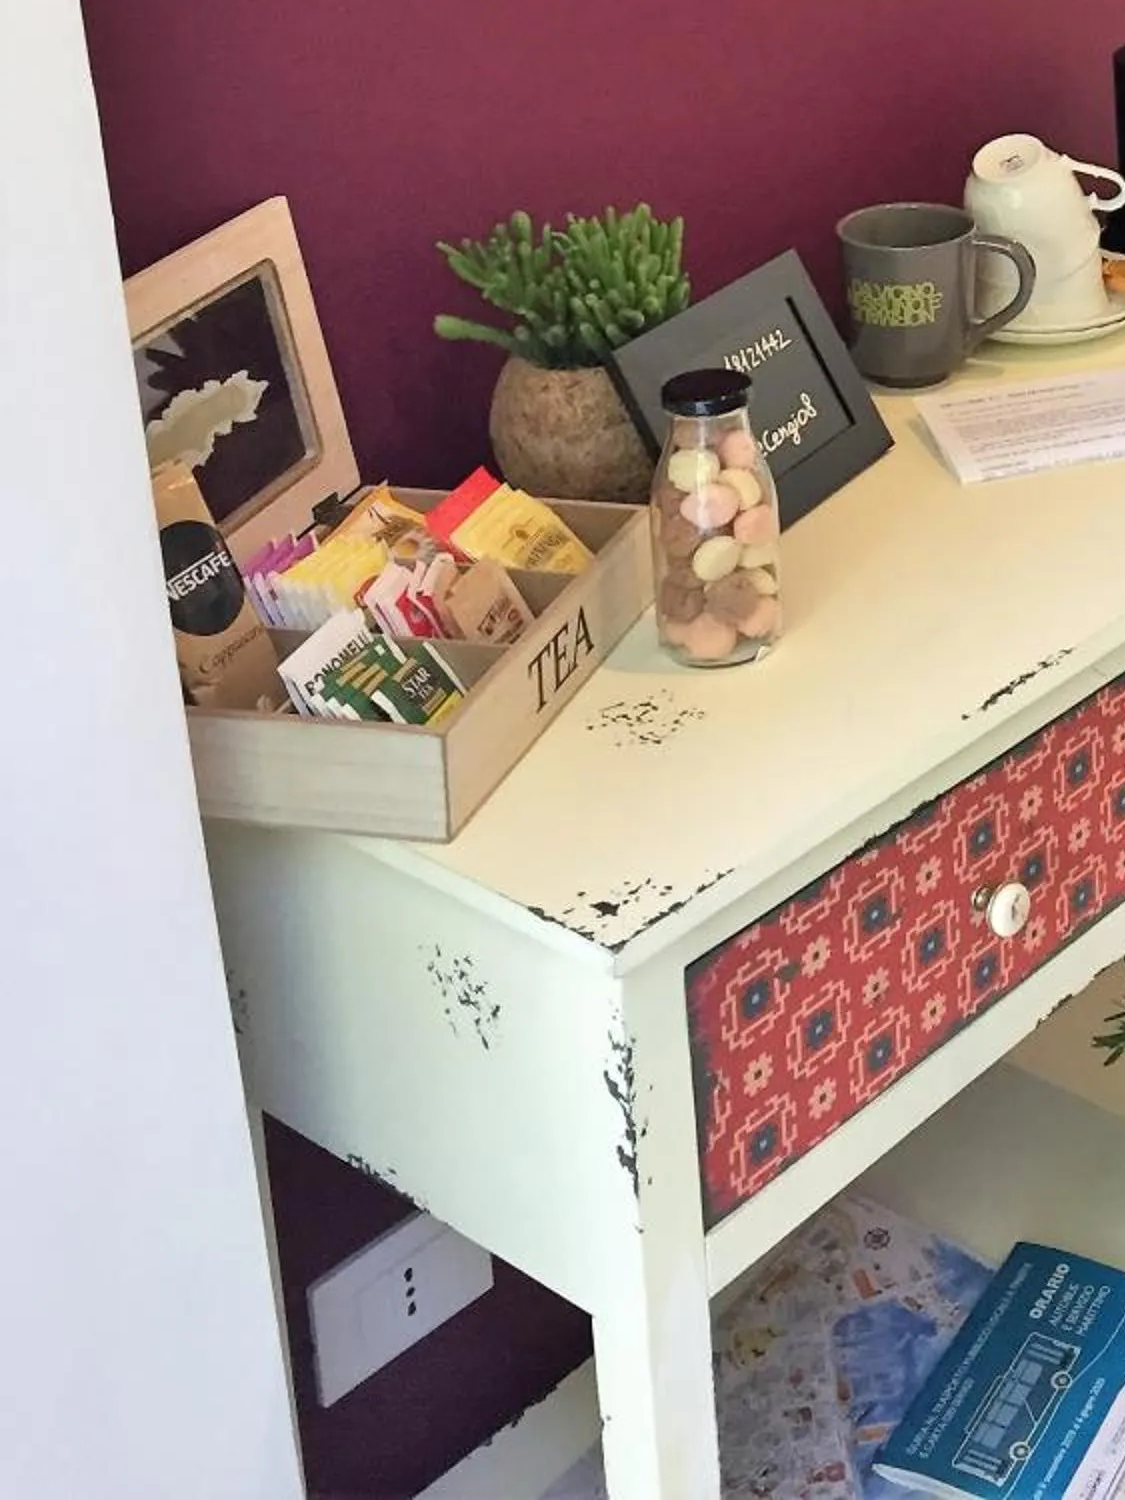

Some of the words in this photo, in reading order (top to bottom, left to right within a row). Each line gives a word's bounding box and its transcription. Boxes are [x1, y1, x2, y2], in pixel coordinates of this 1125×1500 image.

[401, 666, 432, 698] STAR
[528, 605, 594, 713] TEA
[1029, 1263, 1071, 1320] ORARIO
